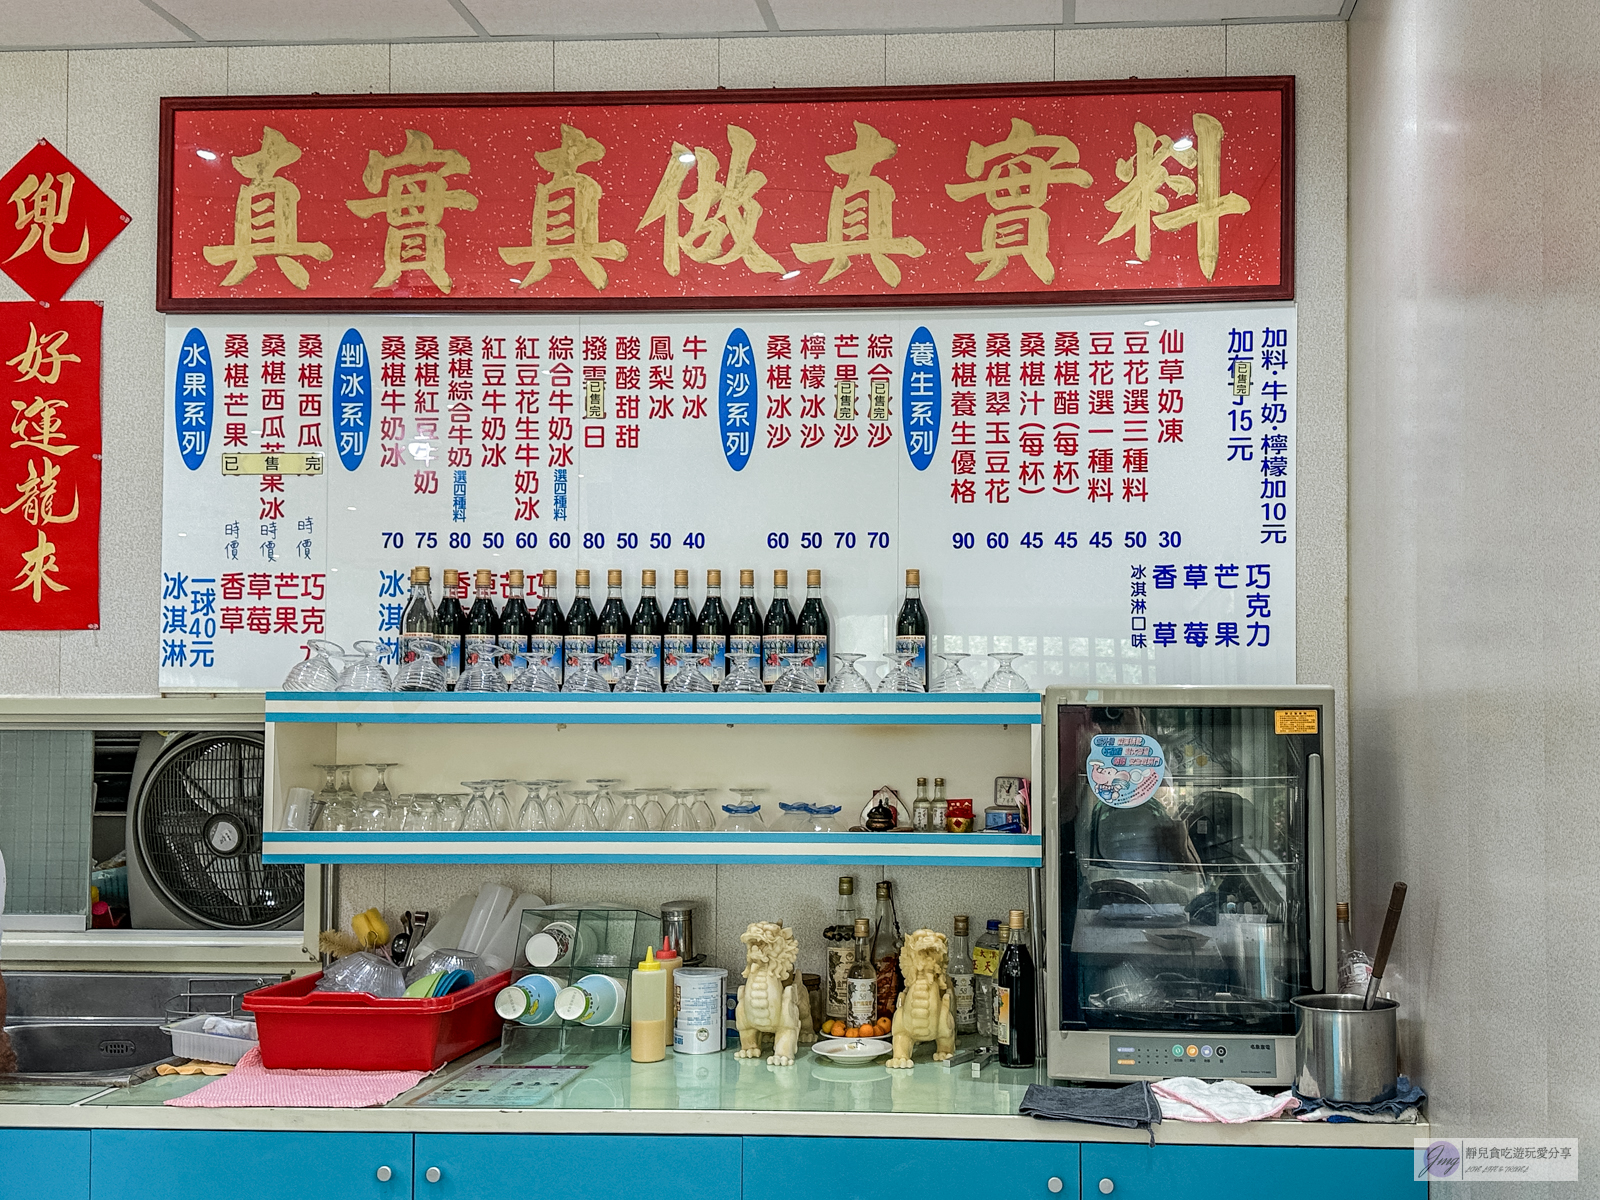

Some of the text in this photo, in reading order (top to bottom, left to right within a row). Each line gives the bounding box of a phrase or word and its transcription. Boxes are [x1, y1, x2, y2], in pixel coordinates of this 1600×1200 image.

[8, 171, 90, 265] 兜
[202, 111, 1251, 294] 真實真做真實料
[182, 343, 206, 456] 水果系列
[223, 333, 248, 475] 桑椹芒果
[297, 333, 322, 475] 桑椹西瓜
[340, 342, 364, 456] 剉冰系列
[380, 335, 405, 467] 桑椹牛奶冰
[414, 335, 439, 494] 桑椹紅豆牛奶
[448, 335, 473, 467] 桑椹綜合牛奶
[481, 337, 506, 468] 紅豆牛奶冰
[514, 336, 539, 521] 紅豆花生牛奶冰
[548, 335, 573, 467] 綜合牛奶冰
[582, 335, 607, 449] 撥雲日
[589, 381, 601, 417] 已售完
[615, 336, 640, 449] 酸酸甜甜
[648, 335, 674, 420] 鳳梨冰
[682, 336, 707, 419] 牛奶冰
[726, 342, 750, 456] 冰沙系列
[766, 334, 792, 448] 桑椹冰沙
[799, 335, 825, 448] 檸檬冰沙
[840, 382, 851, 419] 已售完
[873, 383, 886, 419] 已售完
[909, 341, 934, 456] 養生系列
[950, 332, 976, 503] 桑椹養生優格
[985, 332, 1010, 504] 桑椹翠玉豆花
[1087, 331, 1114, 502] 豆花選一種料
[1122, 331, 1149, 502] 豆花選三種料
[1157, 329, 1184, 443] 仙草奶凍
[1236, 363, 1247, 394] 已售完
[0, 322, 81, 603] 好運龍來
[224, 456, 321, 471] 已售完
[225, 520, 240, 561] 時價
[260, 521, 278, 562] 時價
[296, 516, 313, 560] 時價
[382, 531, 571, 549] 70 75 80 50 60 60
[582, 532, 705, 550] 80 50 50 40
[766, 531, 890, 549] 60 50 70 70
[952, 530, 1182, 549] 90 60 45 45 45 50 30
[161, 571, 189, 667] 冰淇淋
[187, 577, 217, 668] 一球40元
[1130, 565, 1146, 647] 冰淇淋口味
[1245, 563, 1271, 647] 巧克力
